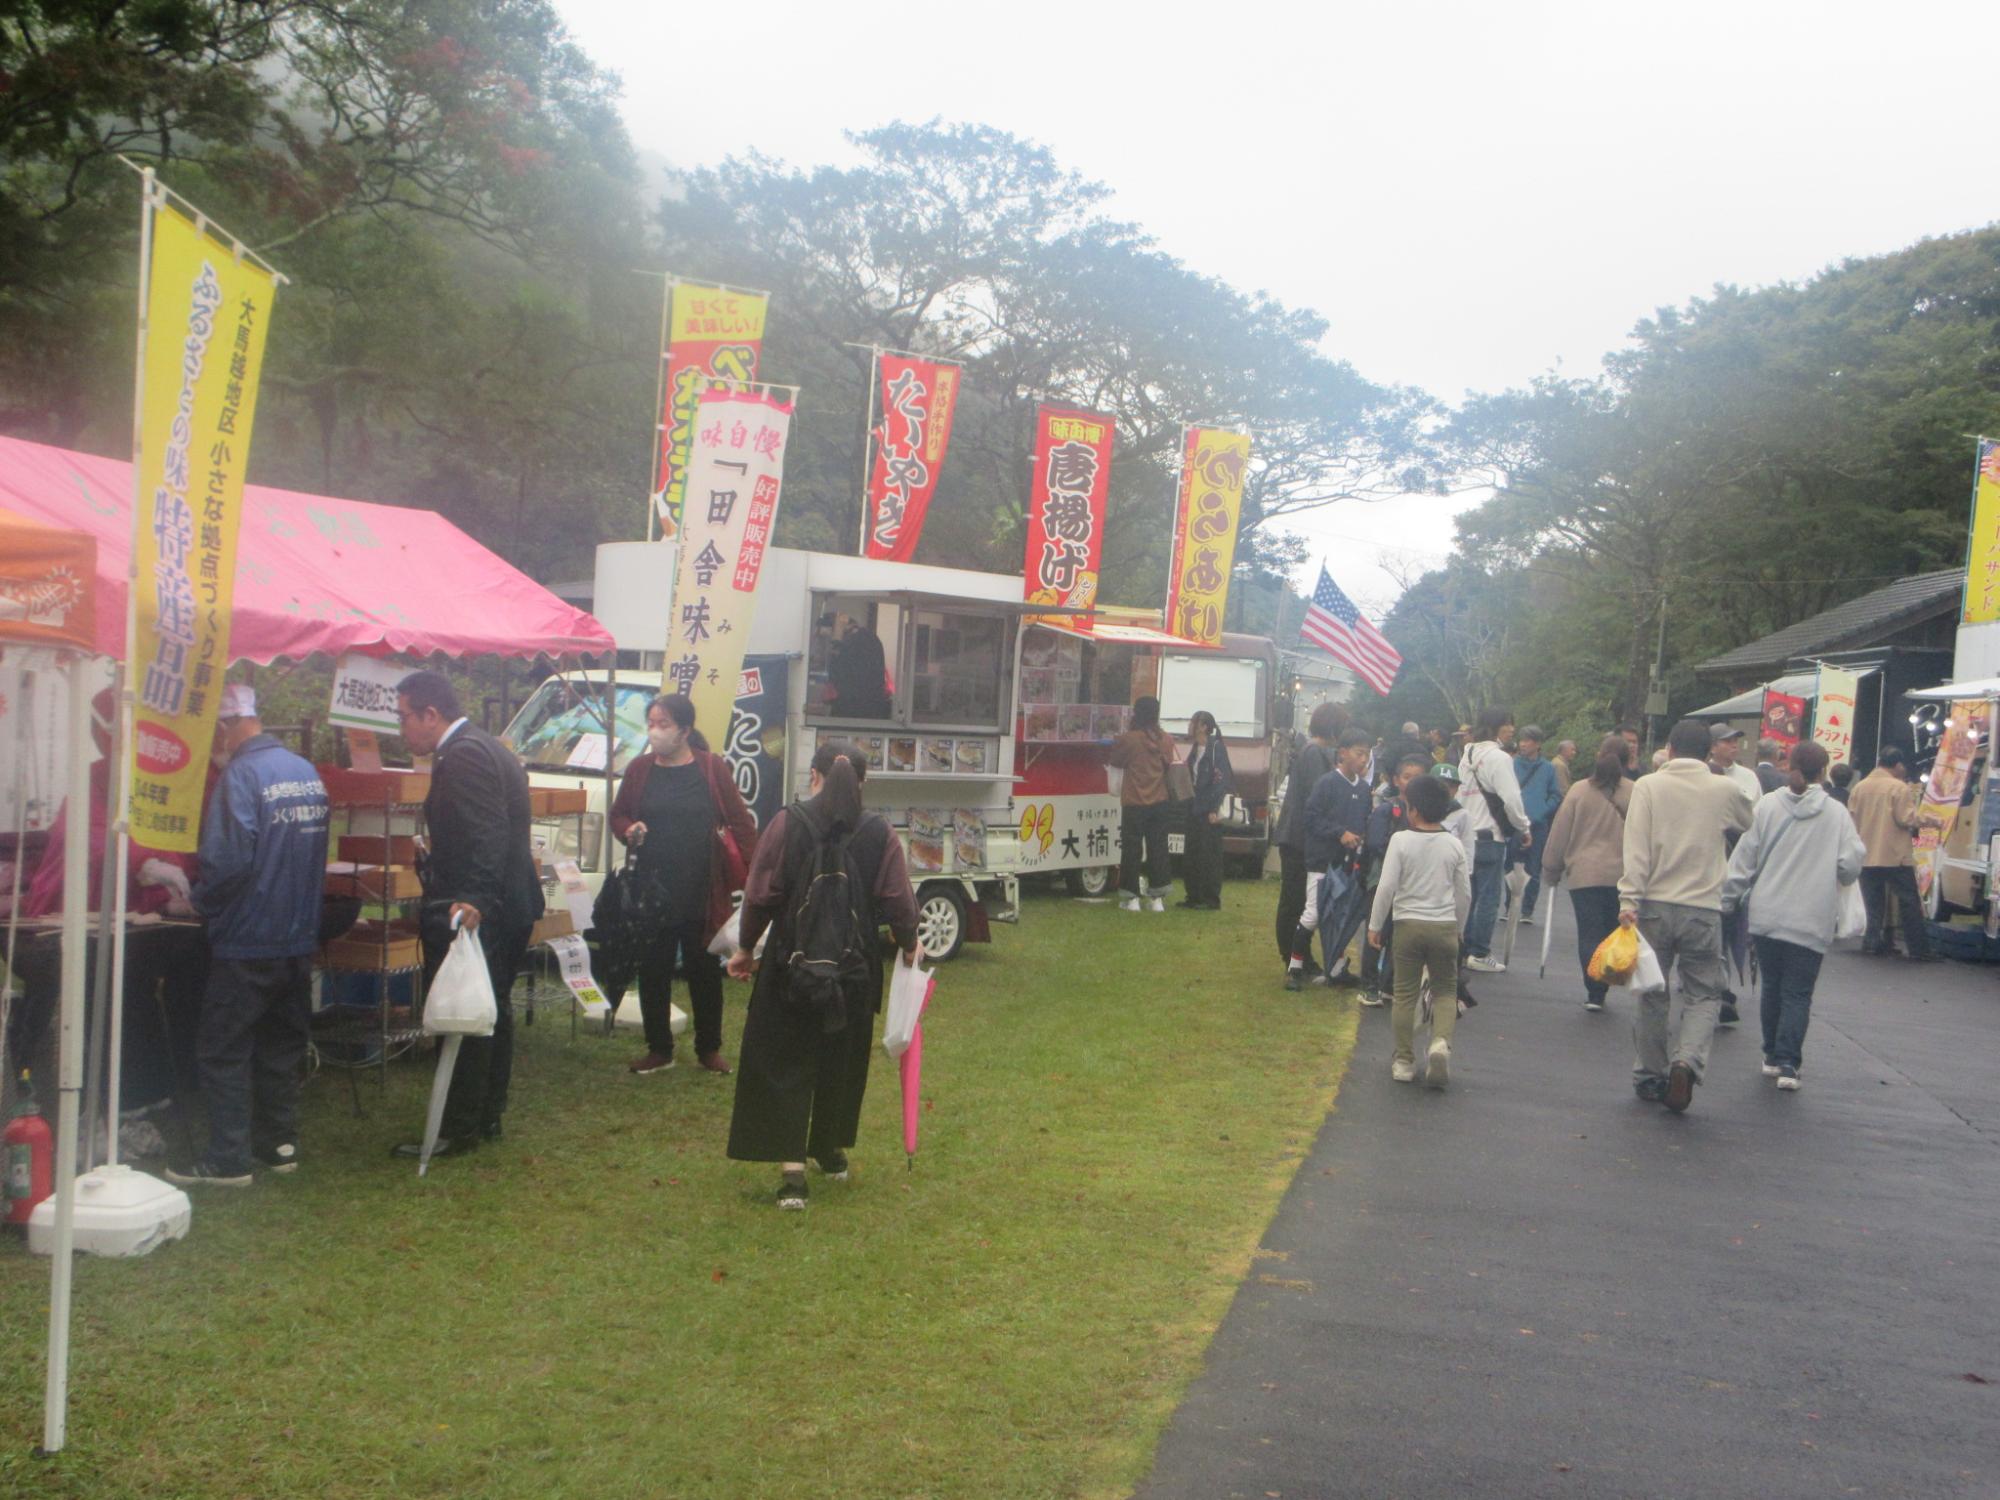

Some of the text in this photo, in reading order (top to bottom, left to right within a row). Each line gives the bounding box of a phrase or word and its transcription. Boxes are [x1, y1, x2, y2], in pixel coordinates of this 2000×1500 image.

[690, 299, 741, 316] 甘くて
[700, 420, 782, 462] 味自慢
[874, 368, 929, 548] たいやき
[735, 478, 777, 588] 好評販売中
[1039, 440, 1098, 592] 唐揚げ
[1815, 728, 1850, 746] クラフト
[1440, 767, 1452, 778] LA
